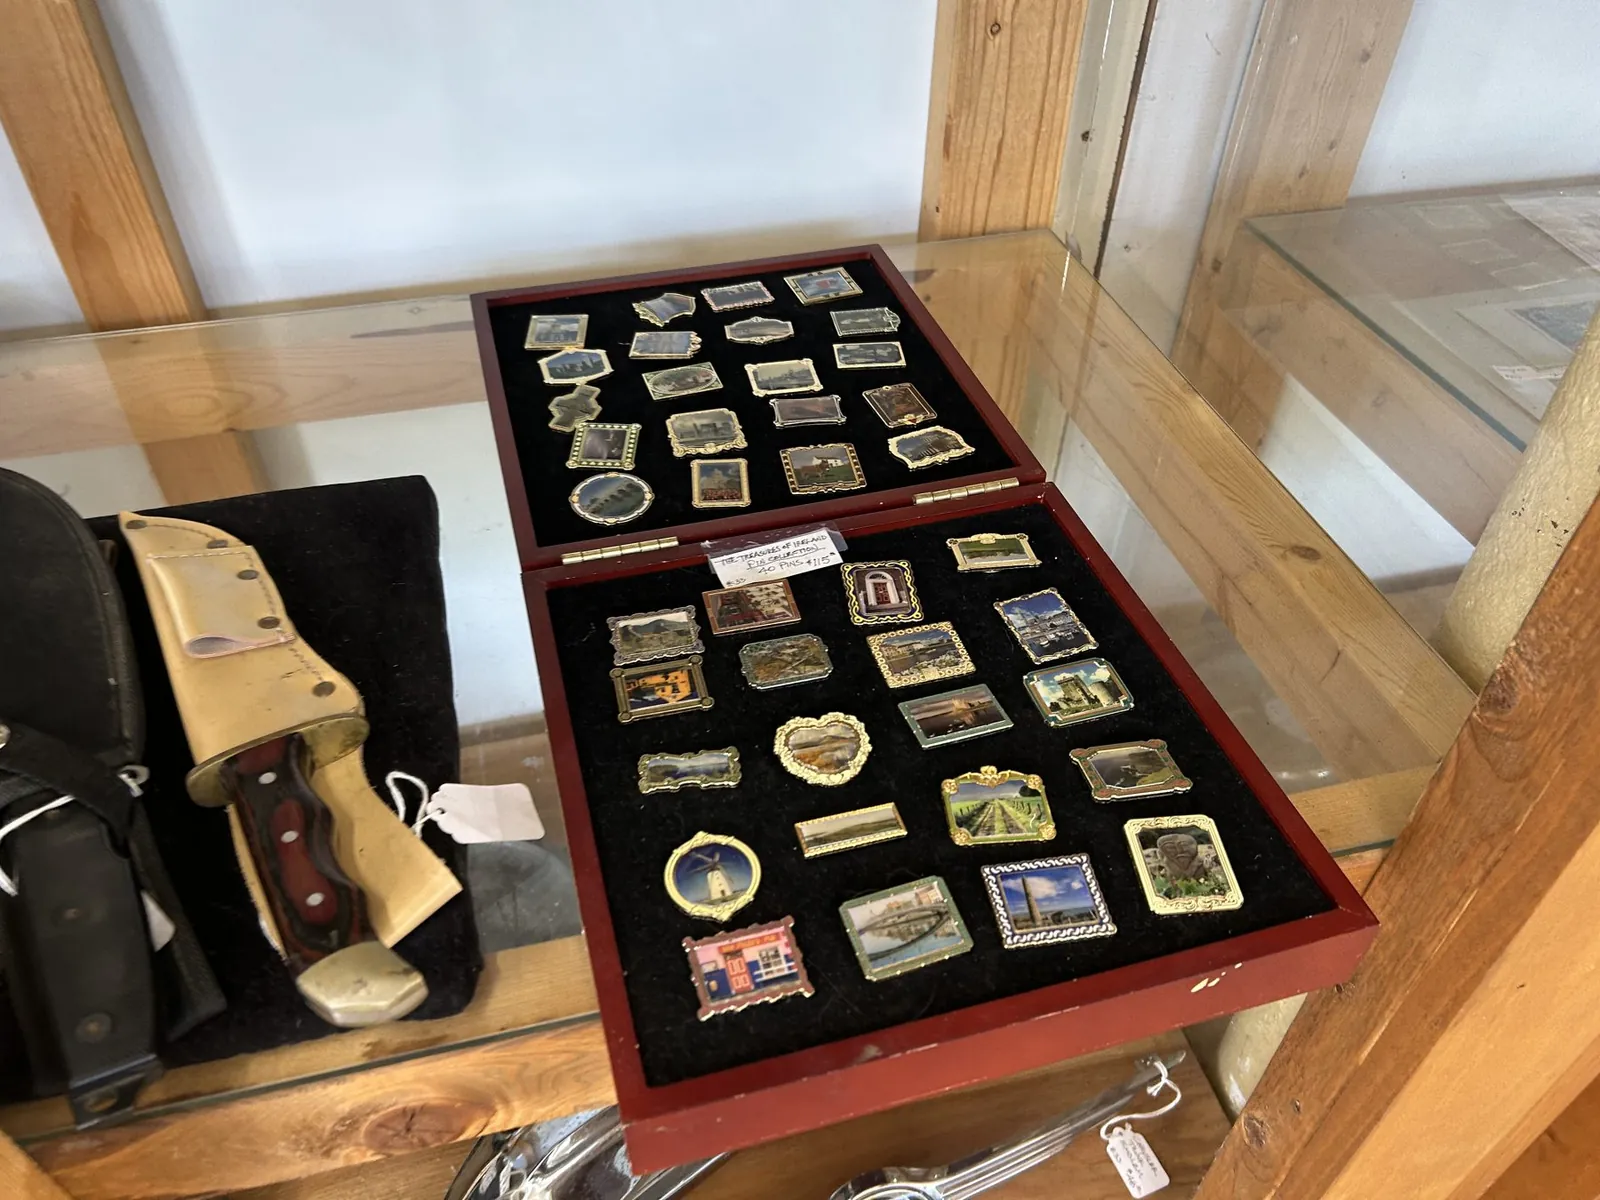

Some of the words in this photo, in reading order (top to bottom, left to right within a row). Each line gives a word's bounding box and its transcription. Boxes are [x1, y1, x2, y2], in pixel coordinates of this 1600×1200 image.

[714, 555, 738, 567] THE
[738, 546, 781, 562] TREASURES
[793, 534, 828, 548] IRELAND
[747, 559, 766, 568] PIN
[767, 544, 819, 561] COLLECTION
[758, 565, 776, 575] 40
[780, 559, 804, 570] PINS
